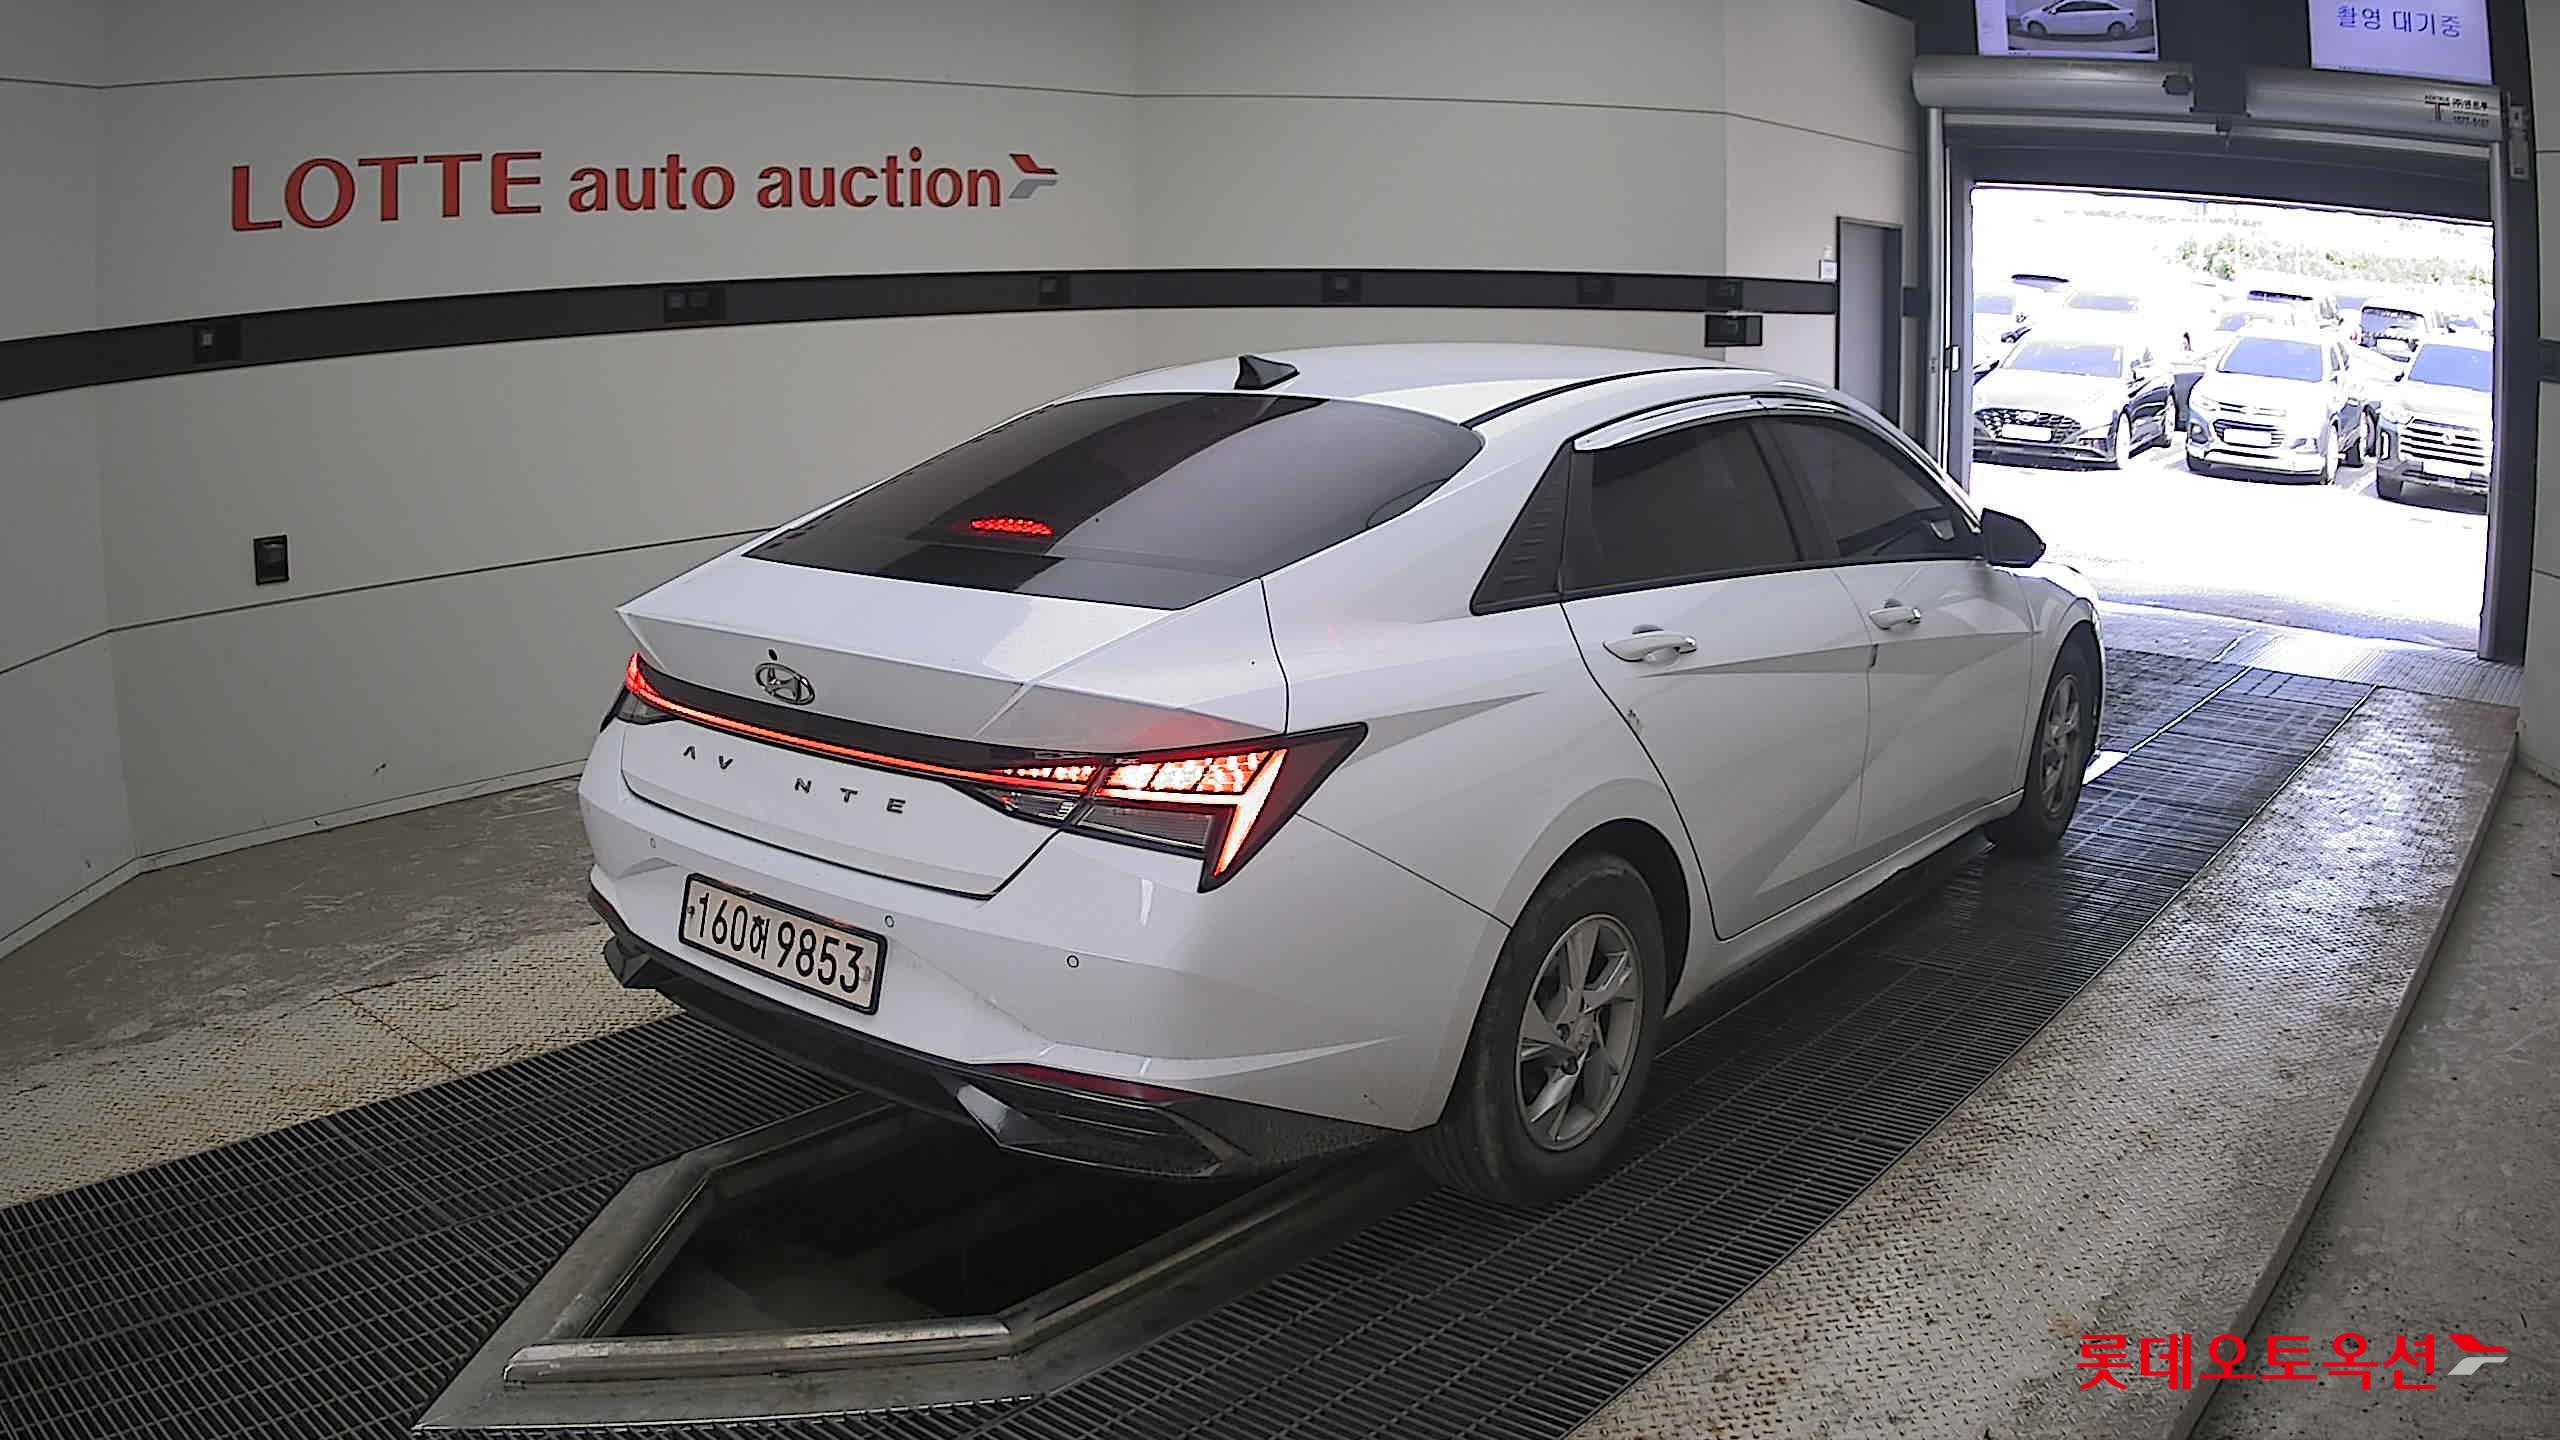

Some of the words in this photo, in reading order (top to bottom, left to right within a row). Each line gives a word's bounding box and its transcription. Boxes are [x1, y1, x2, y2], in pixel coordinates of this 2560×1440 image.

[2337, 5, 2381, 30] 촬영
[2393, 10, 2463, 38] 대기중
[231, 151, 542, 231] LOTTE
[568, 153, 736, 212] auto
[757, 146, 1001, 209] auction
[776, 921, 865, 993] 9853
